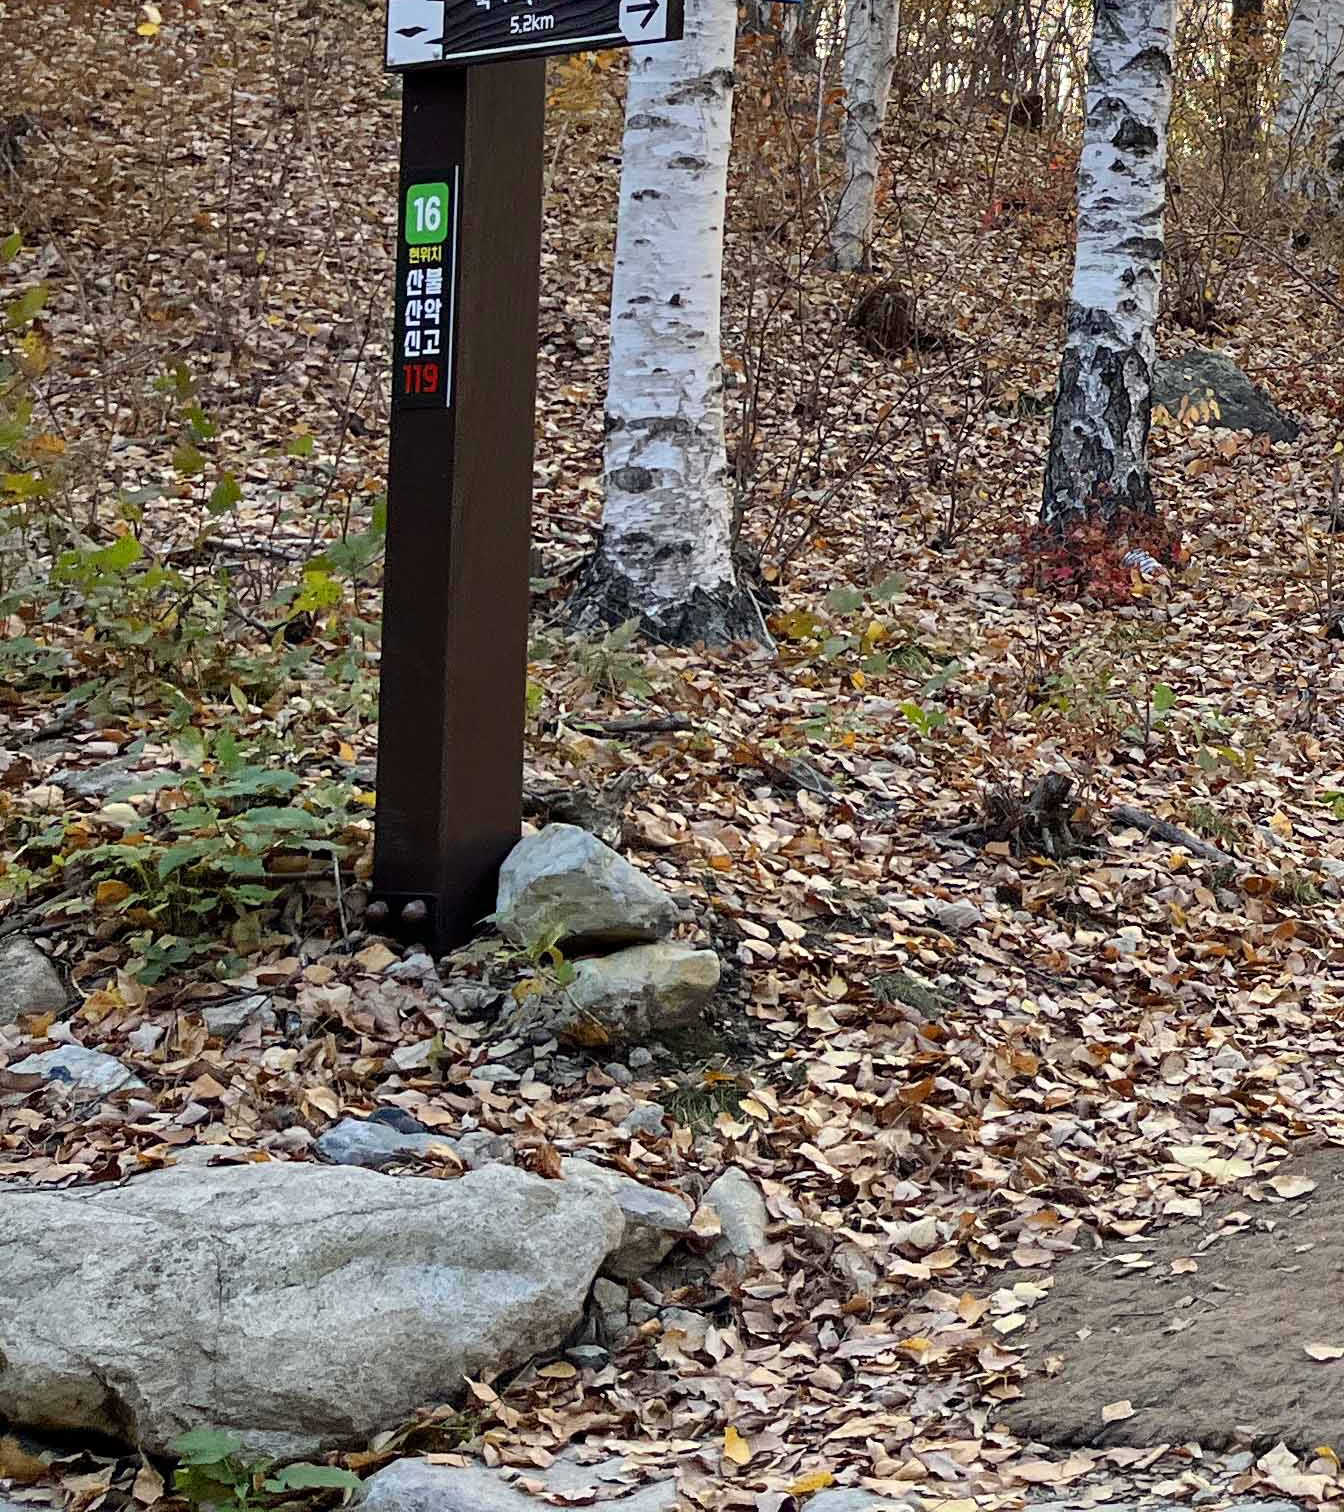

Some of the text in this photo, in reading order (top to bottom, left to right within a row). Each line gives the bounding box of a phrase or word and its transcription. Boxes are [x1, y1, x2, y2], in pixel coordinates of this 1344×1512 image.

[509, 13, 554, 34] 5.2km
[413, 195, 442, 232] 16
[408, 245, 442, 264] 현위치
[406, 267, 443, 297] 산불
[405, 298, 442, 327] 산악
[403, 329, 441, 358] 신고
[403, 363, 440, 394] 119
